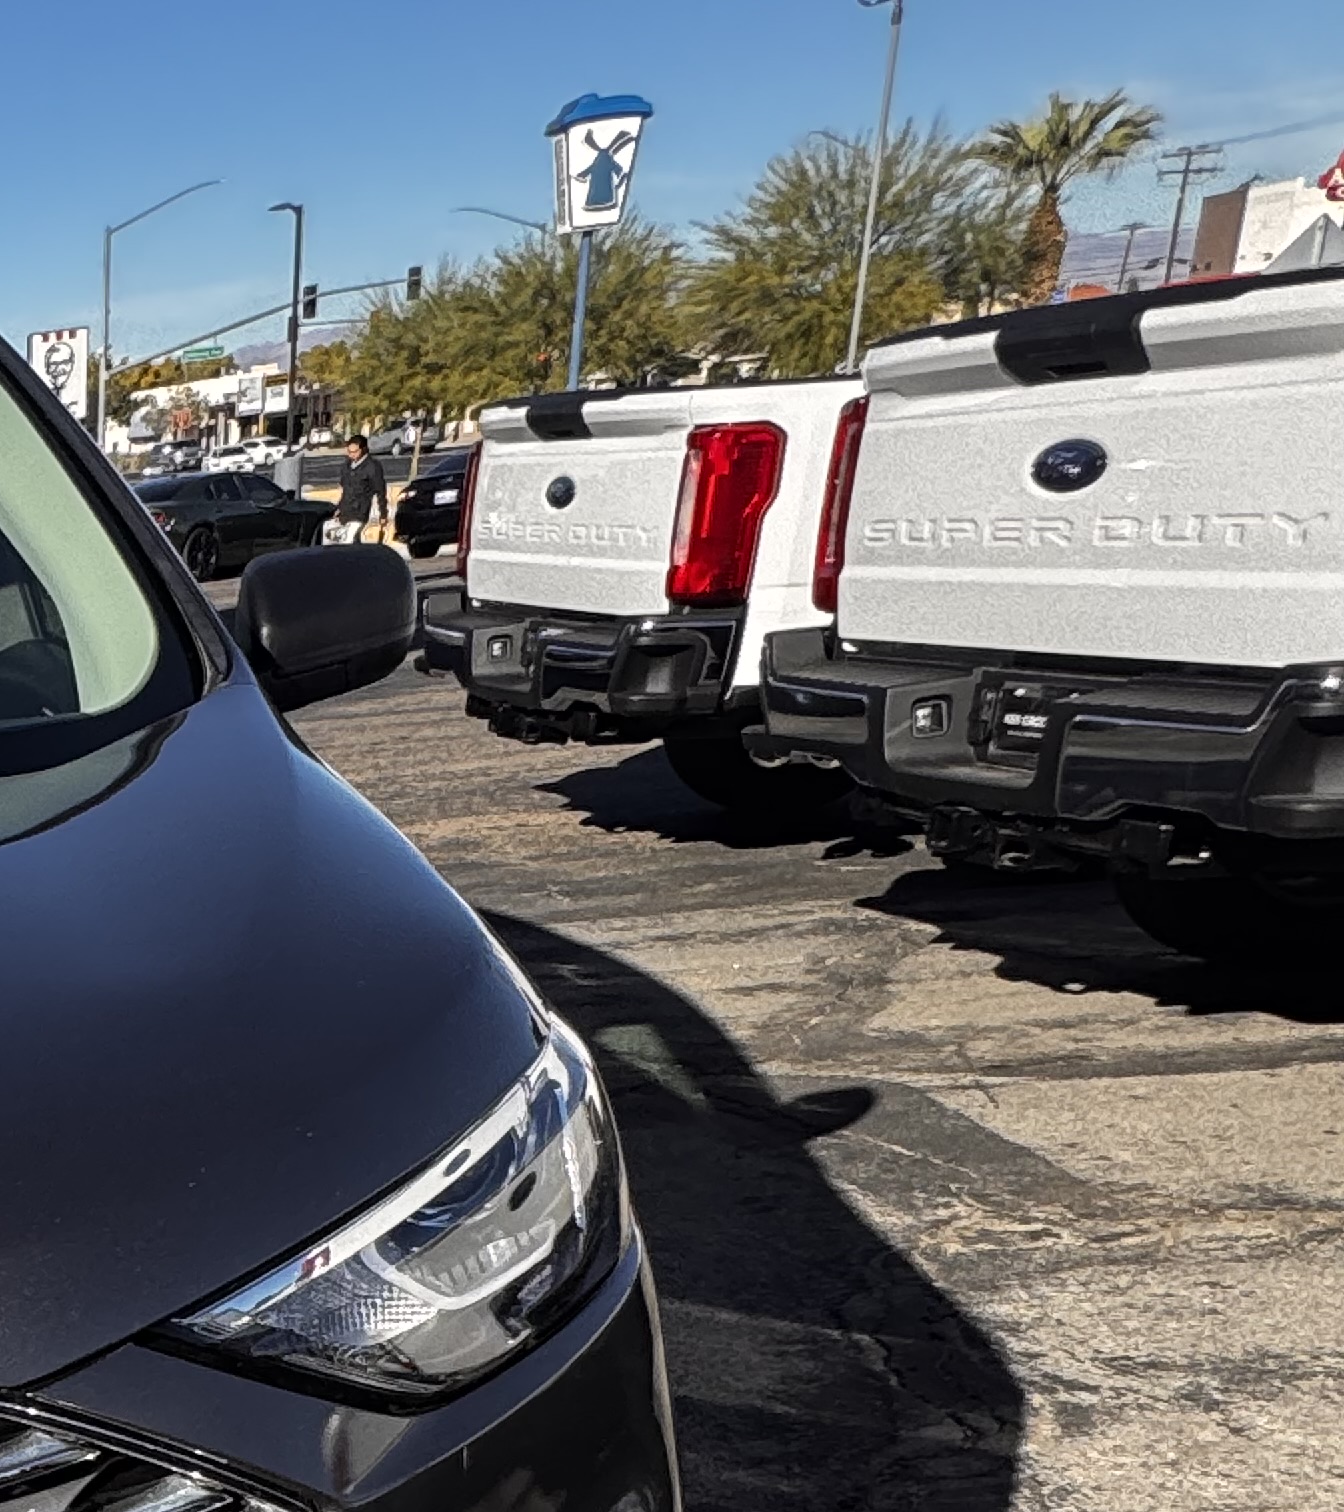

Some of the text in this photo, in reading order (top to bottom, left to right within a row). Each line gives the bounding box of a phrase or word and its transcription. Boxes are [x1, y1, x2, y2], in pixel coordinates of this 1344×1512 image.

[478, 520, 659, 547] SUPER DUTY
[863, 512, 1329, 549] SUPER DUTY
